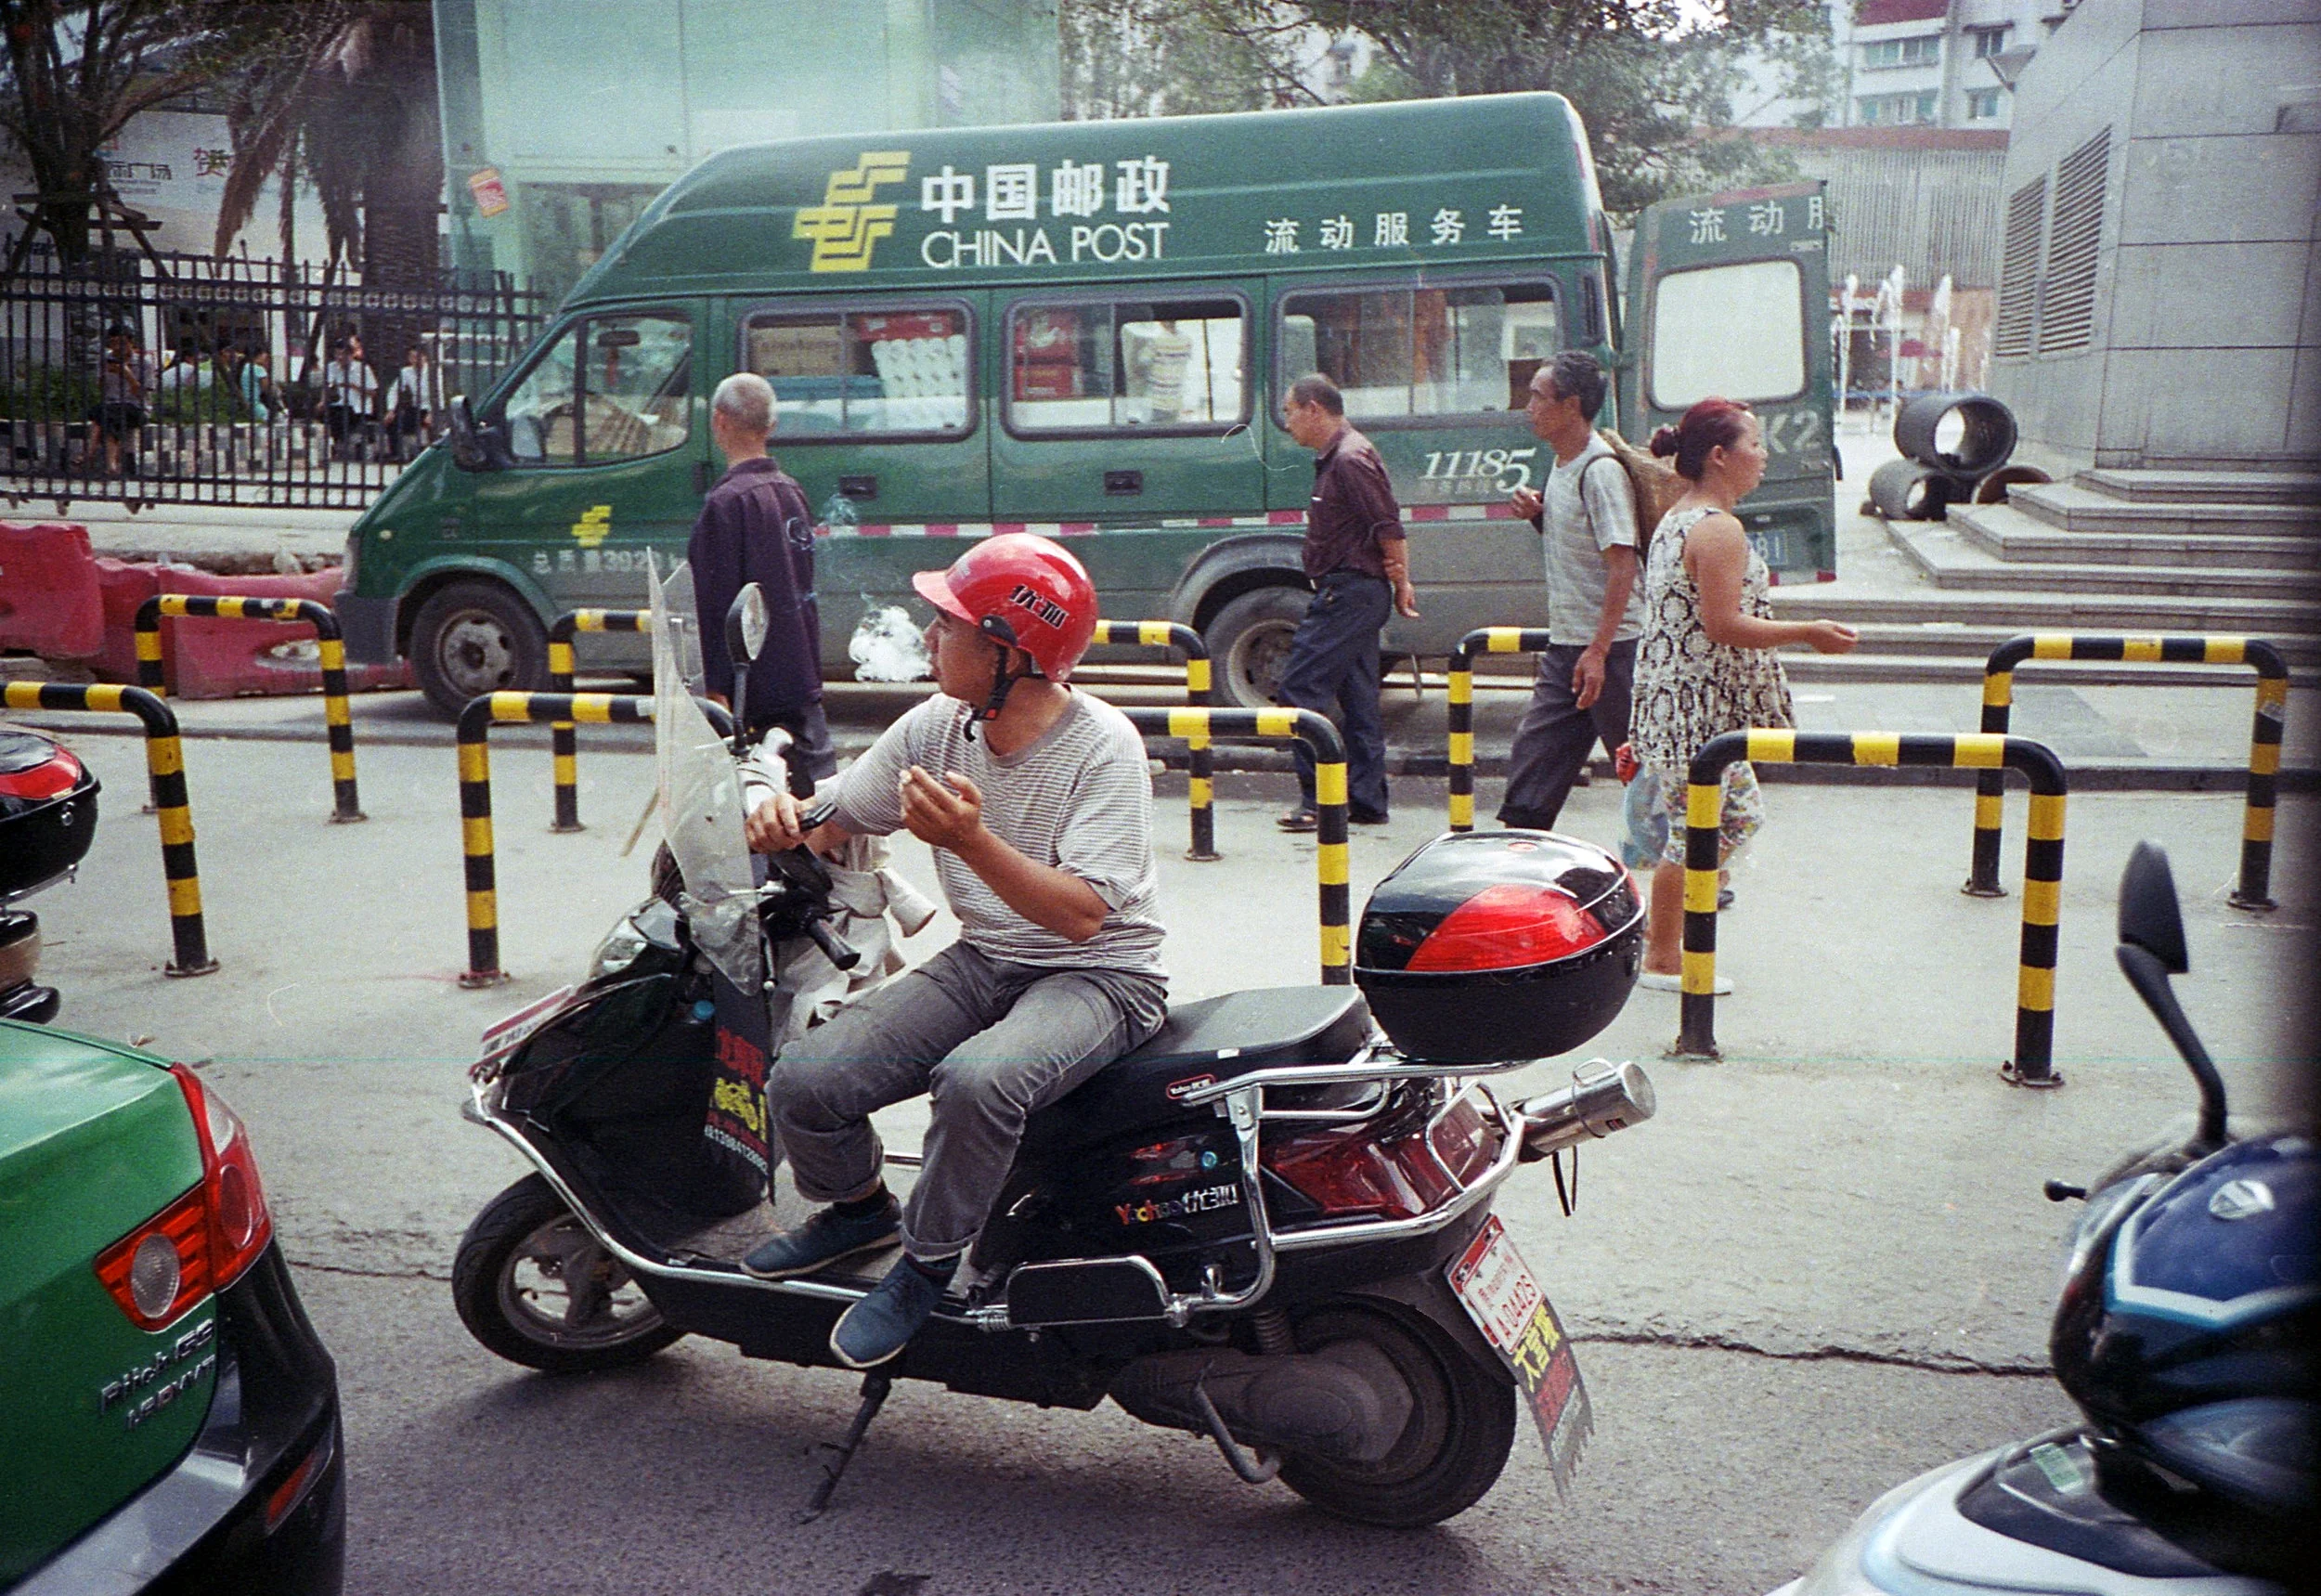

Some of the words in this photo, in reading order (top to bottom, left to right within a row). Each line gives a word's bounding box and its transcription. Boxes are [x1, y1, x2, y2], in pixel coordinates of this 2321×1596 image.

[921, 155, 1171, 224] 中国邮政
[921, 227, 1057, 270] CHINA
[1071, 222, 1171, 263] POST
[1264, 204, 1524, 254] 流动服务车
[1419, 447, 1537, 493] 11185
